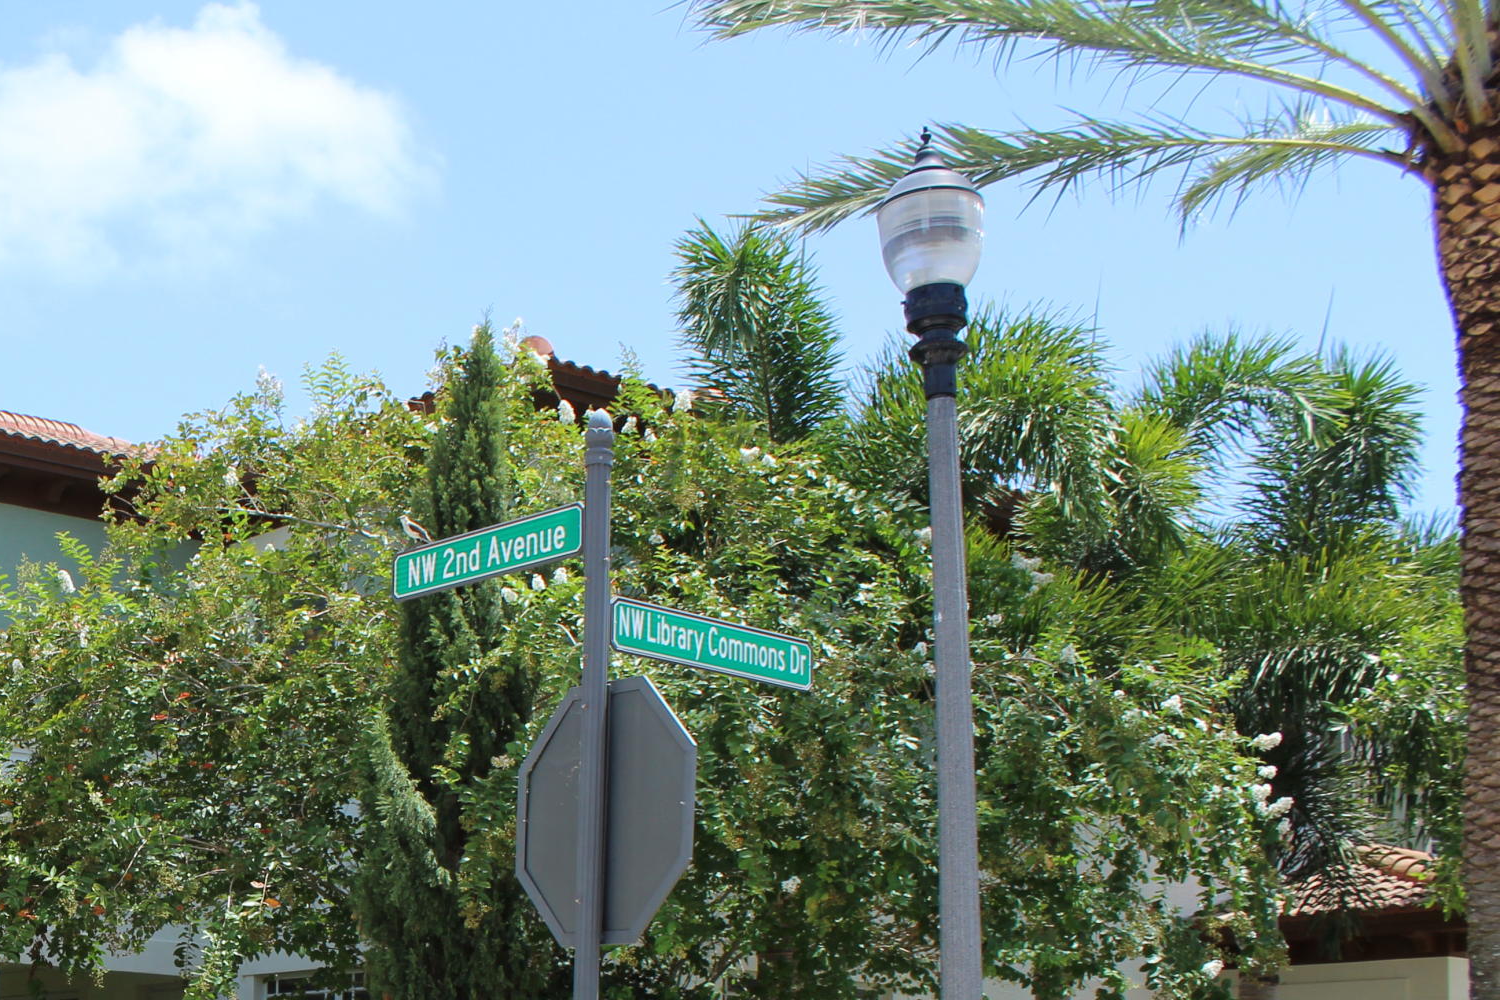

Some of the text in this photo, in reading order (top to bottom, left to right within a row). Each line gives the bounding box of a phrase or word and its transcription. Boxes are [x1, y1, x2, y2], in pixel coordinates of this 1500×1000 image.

[408, 525, 566, 588] NW 2nd Avenue
[619, 606, 806, 676] NW Library Commons Dr
